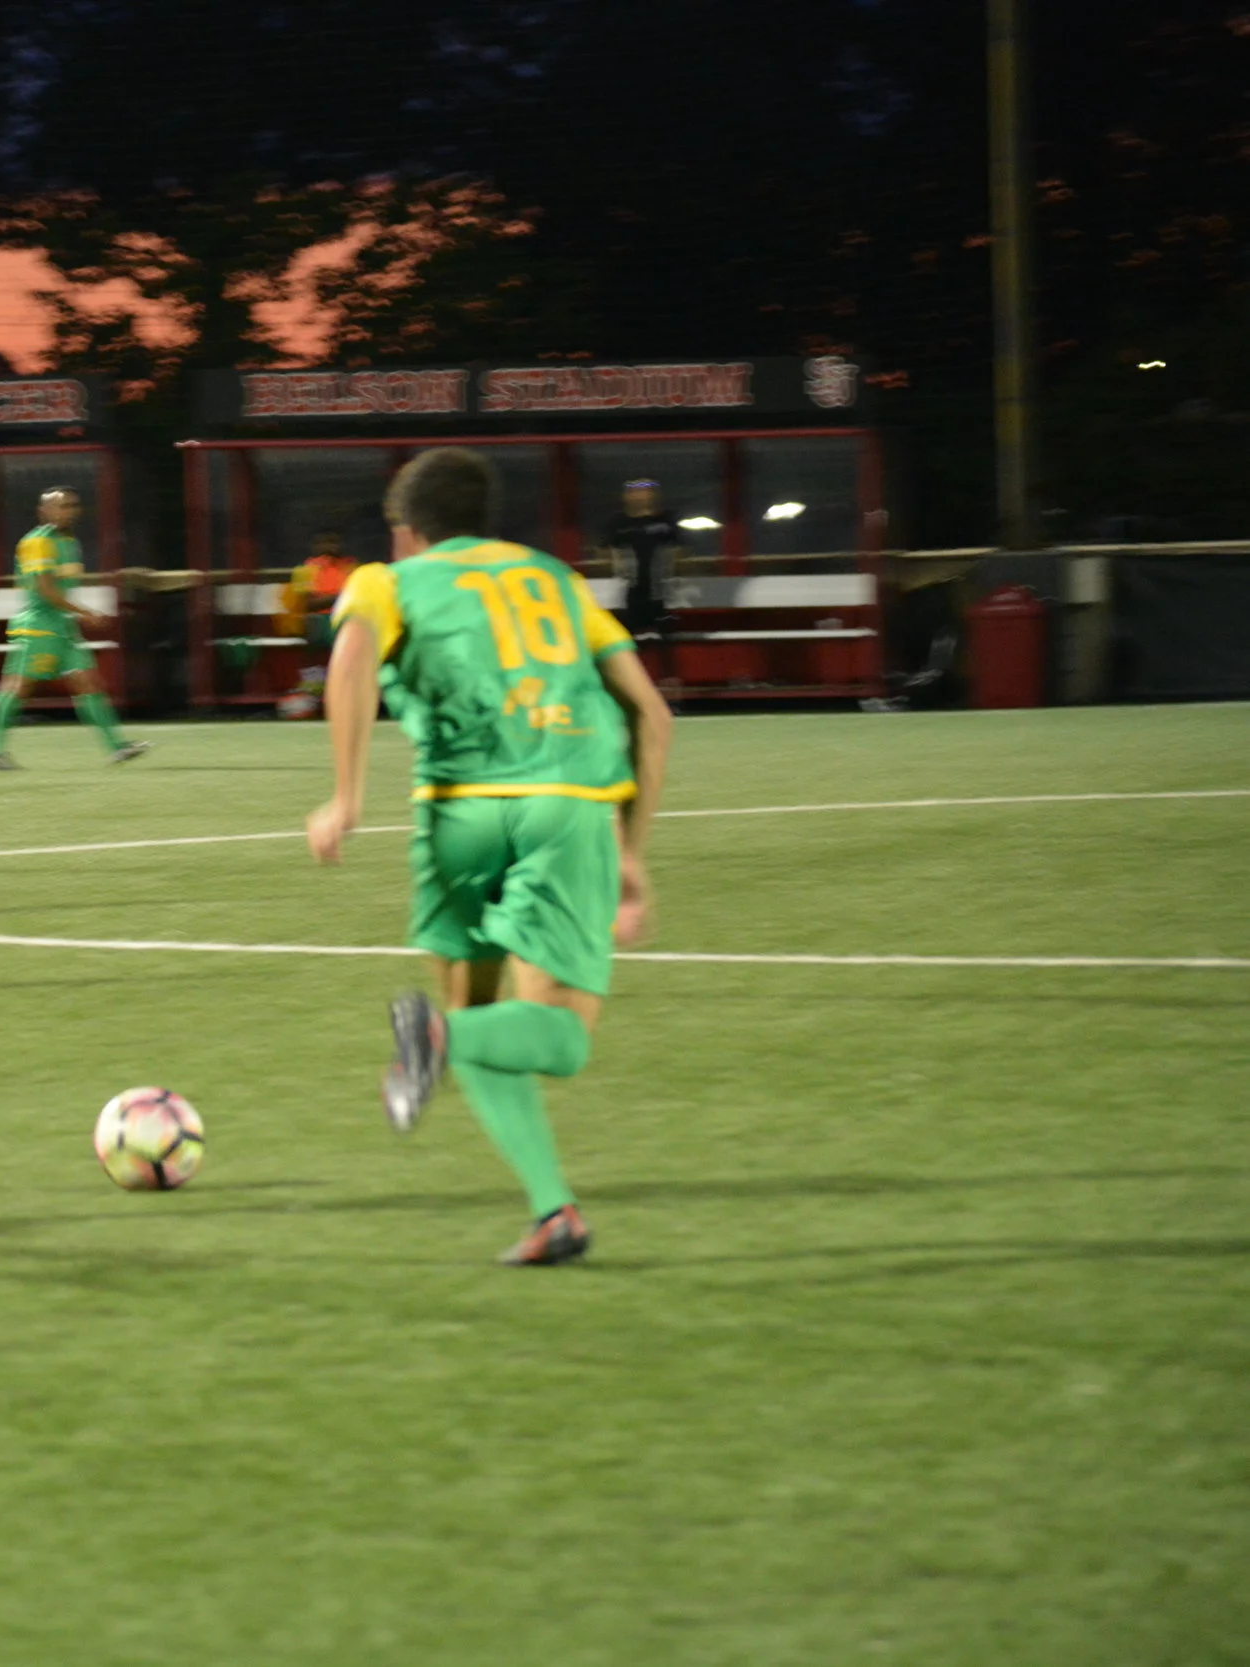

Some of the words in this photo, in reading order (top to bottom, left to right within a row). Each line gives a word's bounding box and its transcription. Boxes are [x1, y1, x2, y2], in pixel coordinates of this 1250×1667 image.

[241, 369, 469, 417] BELSON
[479, 362, 754, 412] STADIUM
[454, 566, 579, 670] 18
